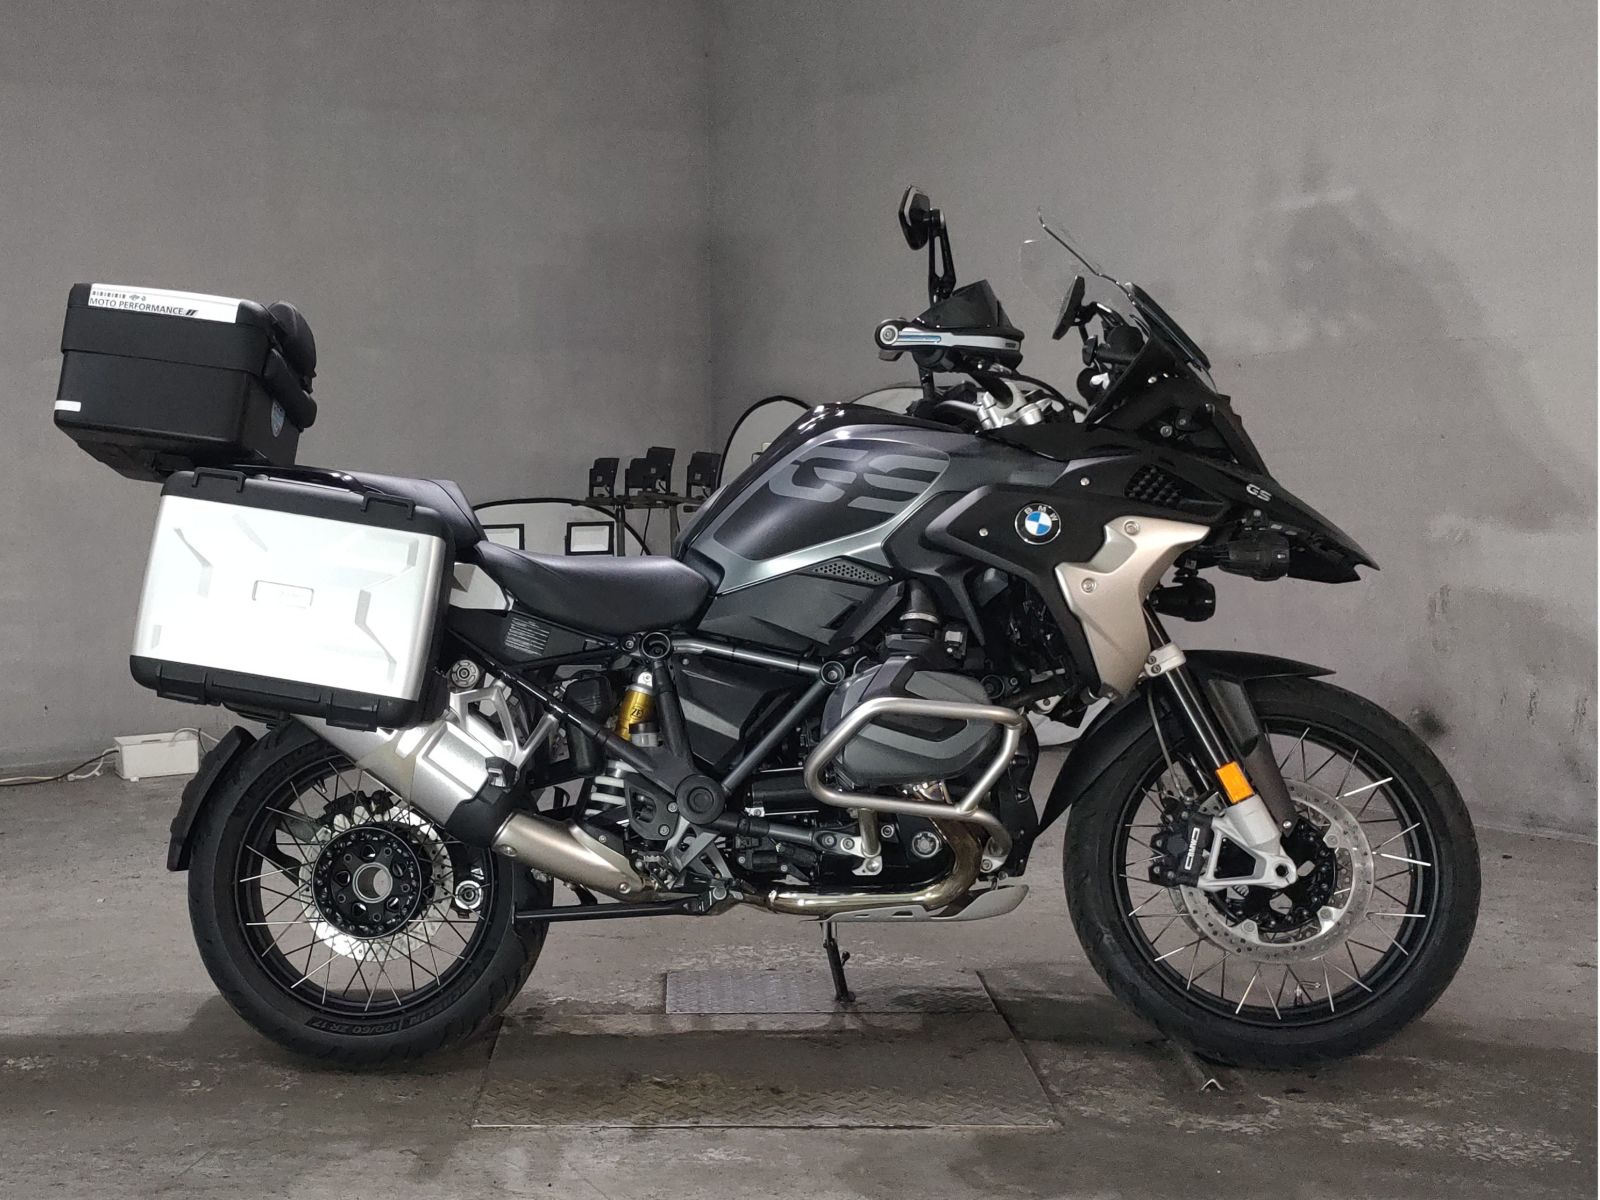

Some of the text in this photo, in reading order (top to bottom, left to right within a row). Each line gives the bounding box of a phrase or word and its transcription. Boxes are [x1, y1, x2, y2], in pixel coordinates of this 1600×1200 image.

[89, 297, 184, 315] MOTO PERFORMANCE
[768, 445, 950, 514] GS
[1246, 483, 1272, 502] GS
[1024, 505, 1059, 522] BMW
